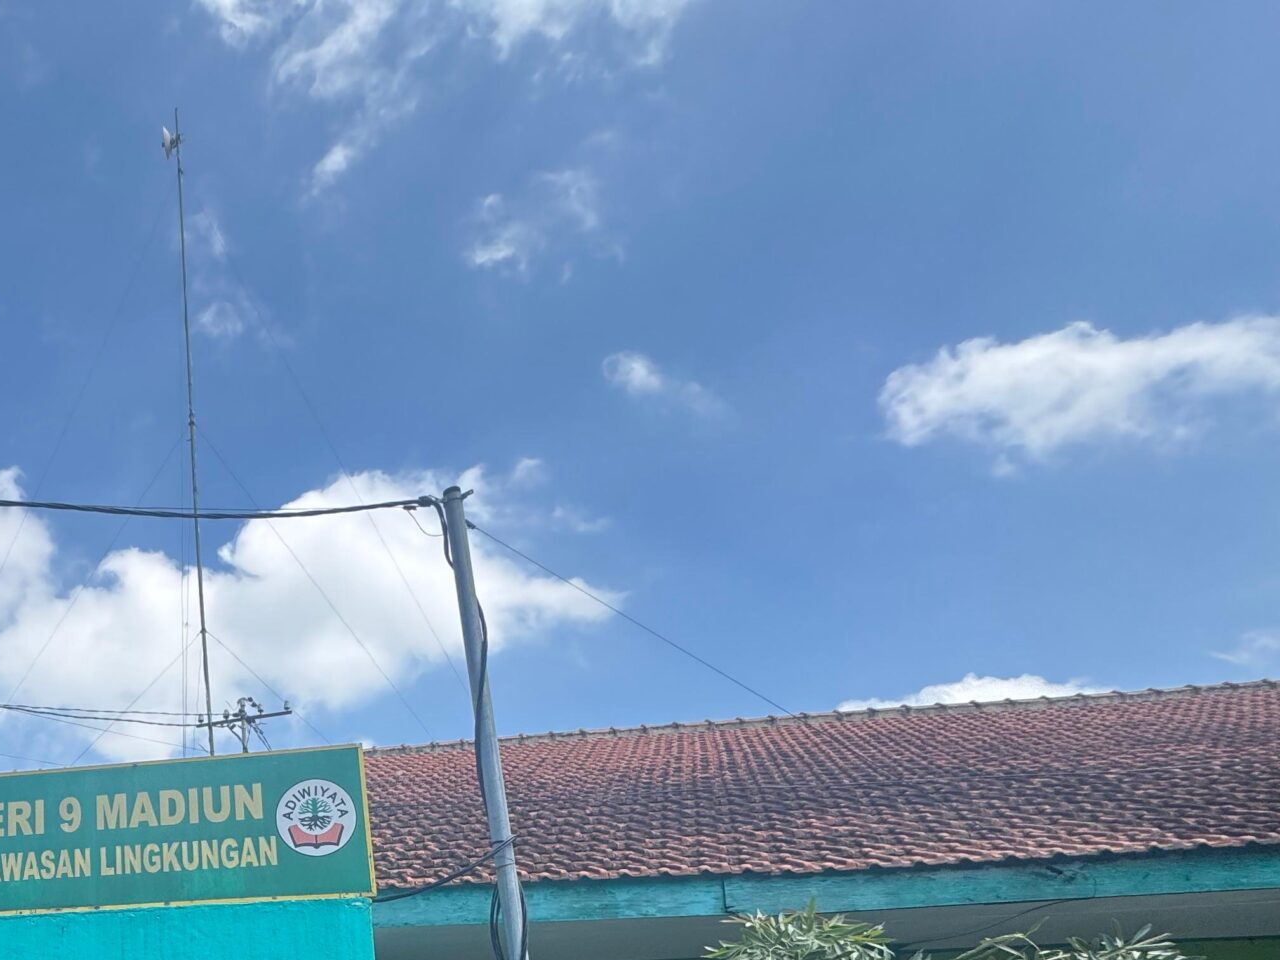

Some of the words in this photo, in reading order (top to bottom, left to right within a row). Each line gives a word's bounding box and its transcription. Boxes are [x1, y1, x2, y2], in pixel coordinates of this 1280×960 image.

[59, 796, 82, 832] 9
[96, 782, 264, 831] MADIUN
[282, 785, 349, 820] ADIWIYATA
[100, 835, 279, 876] LINGKUNGAN
